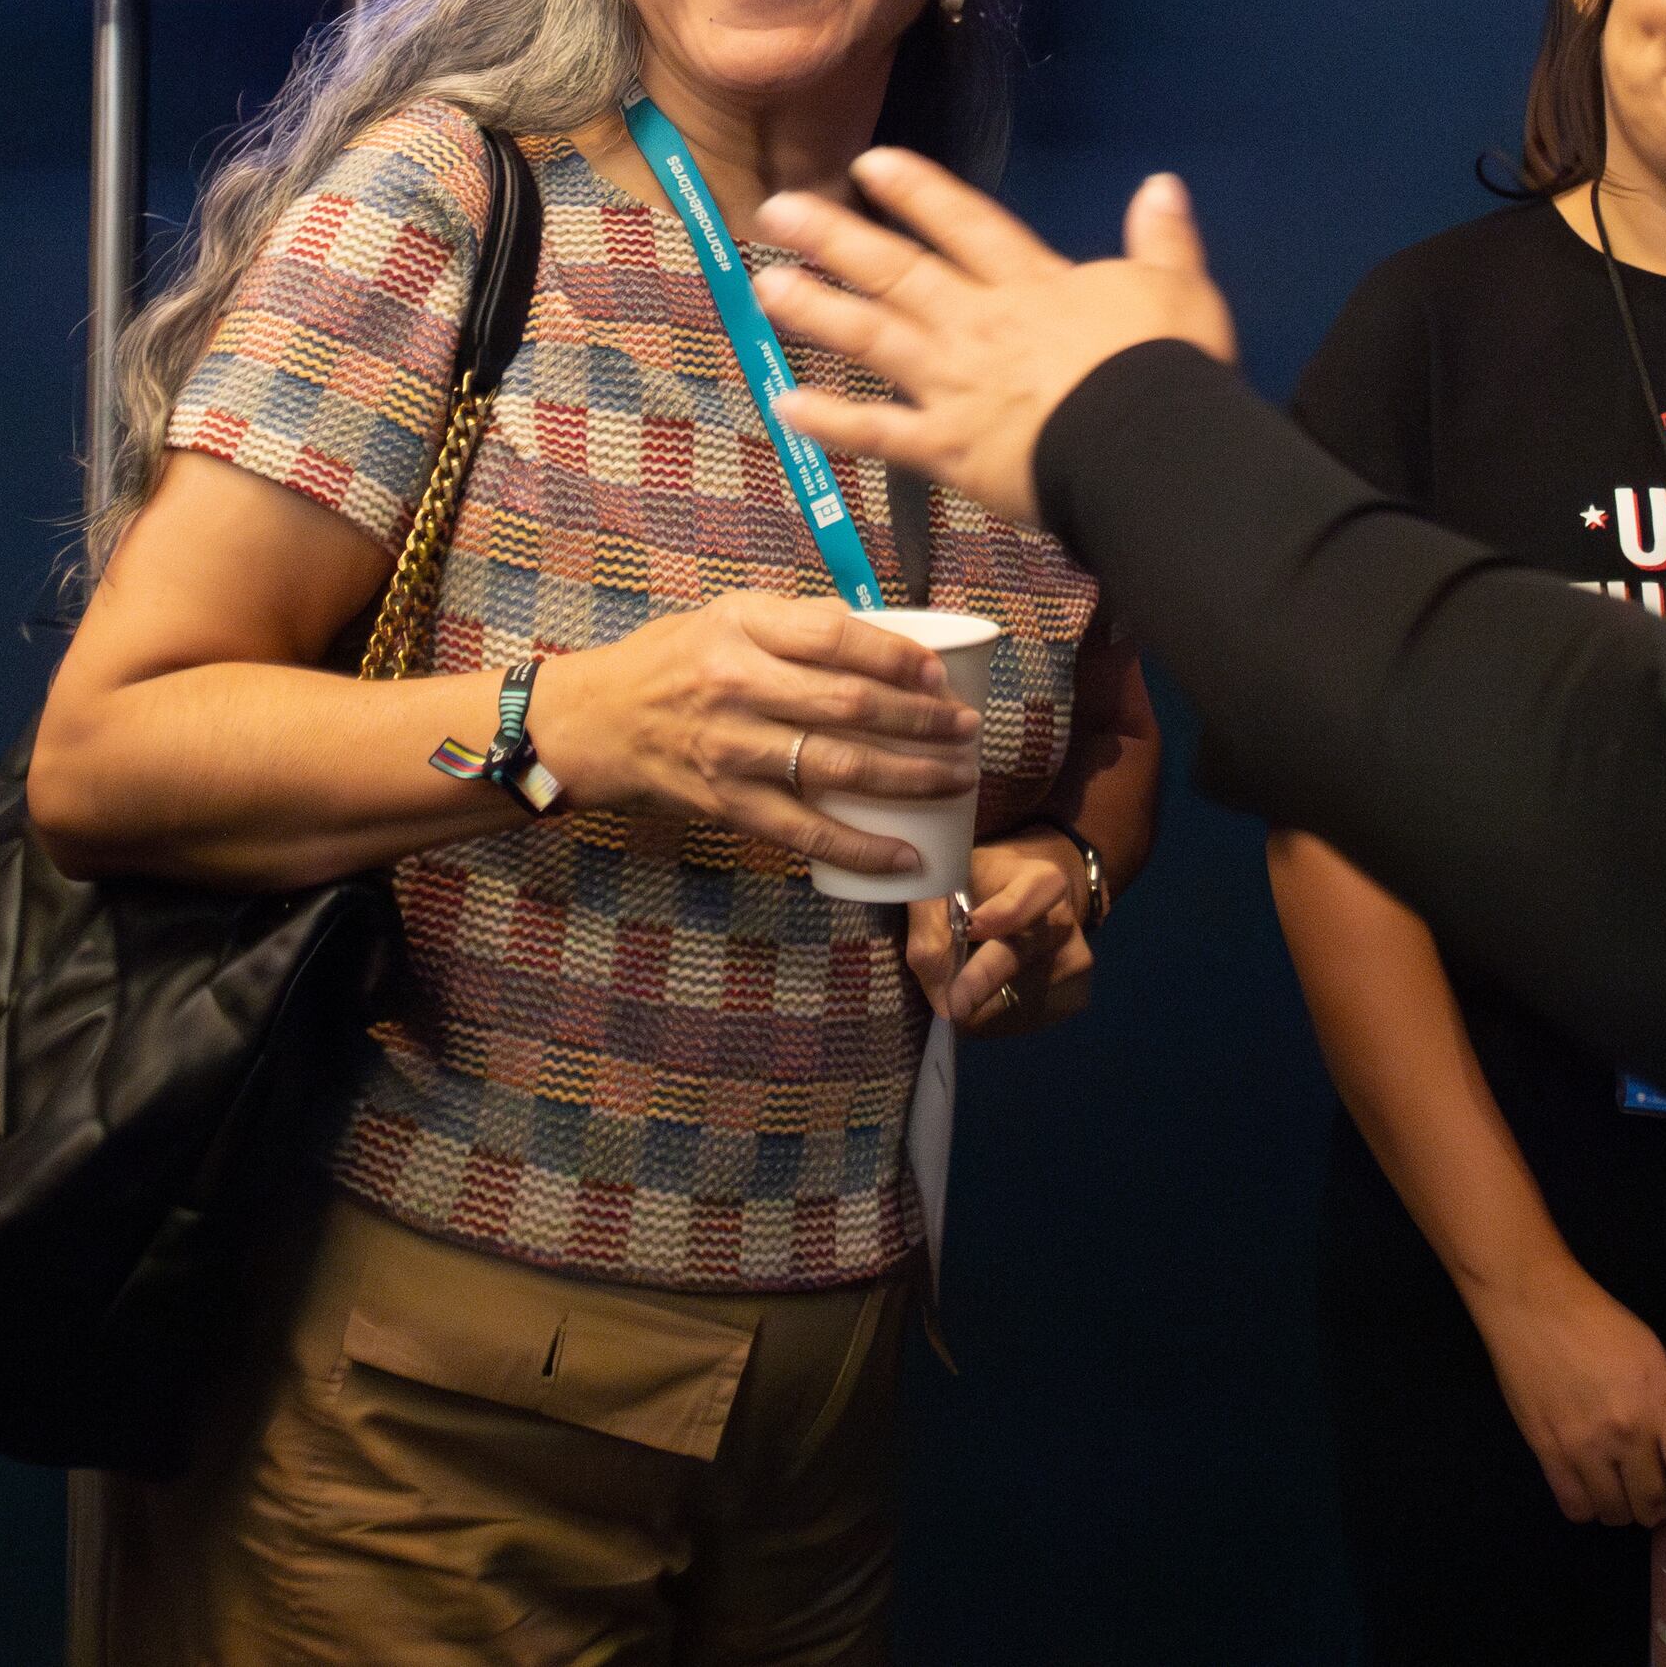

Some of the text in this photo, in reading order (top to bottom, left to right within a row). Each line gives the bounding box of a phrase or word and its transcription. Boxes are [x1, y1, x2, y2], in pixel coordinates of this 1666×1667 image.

[666, 155, 732, 272] #somoslectores
[762, 376, 818, 498] FERIA INTERNNAL
[813, 468, 829, 492] DEL
